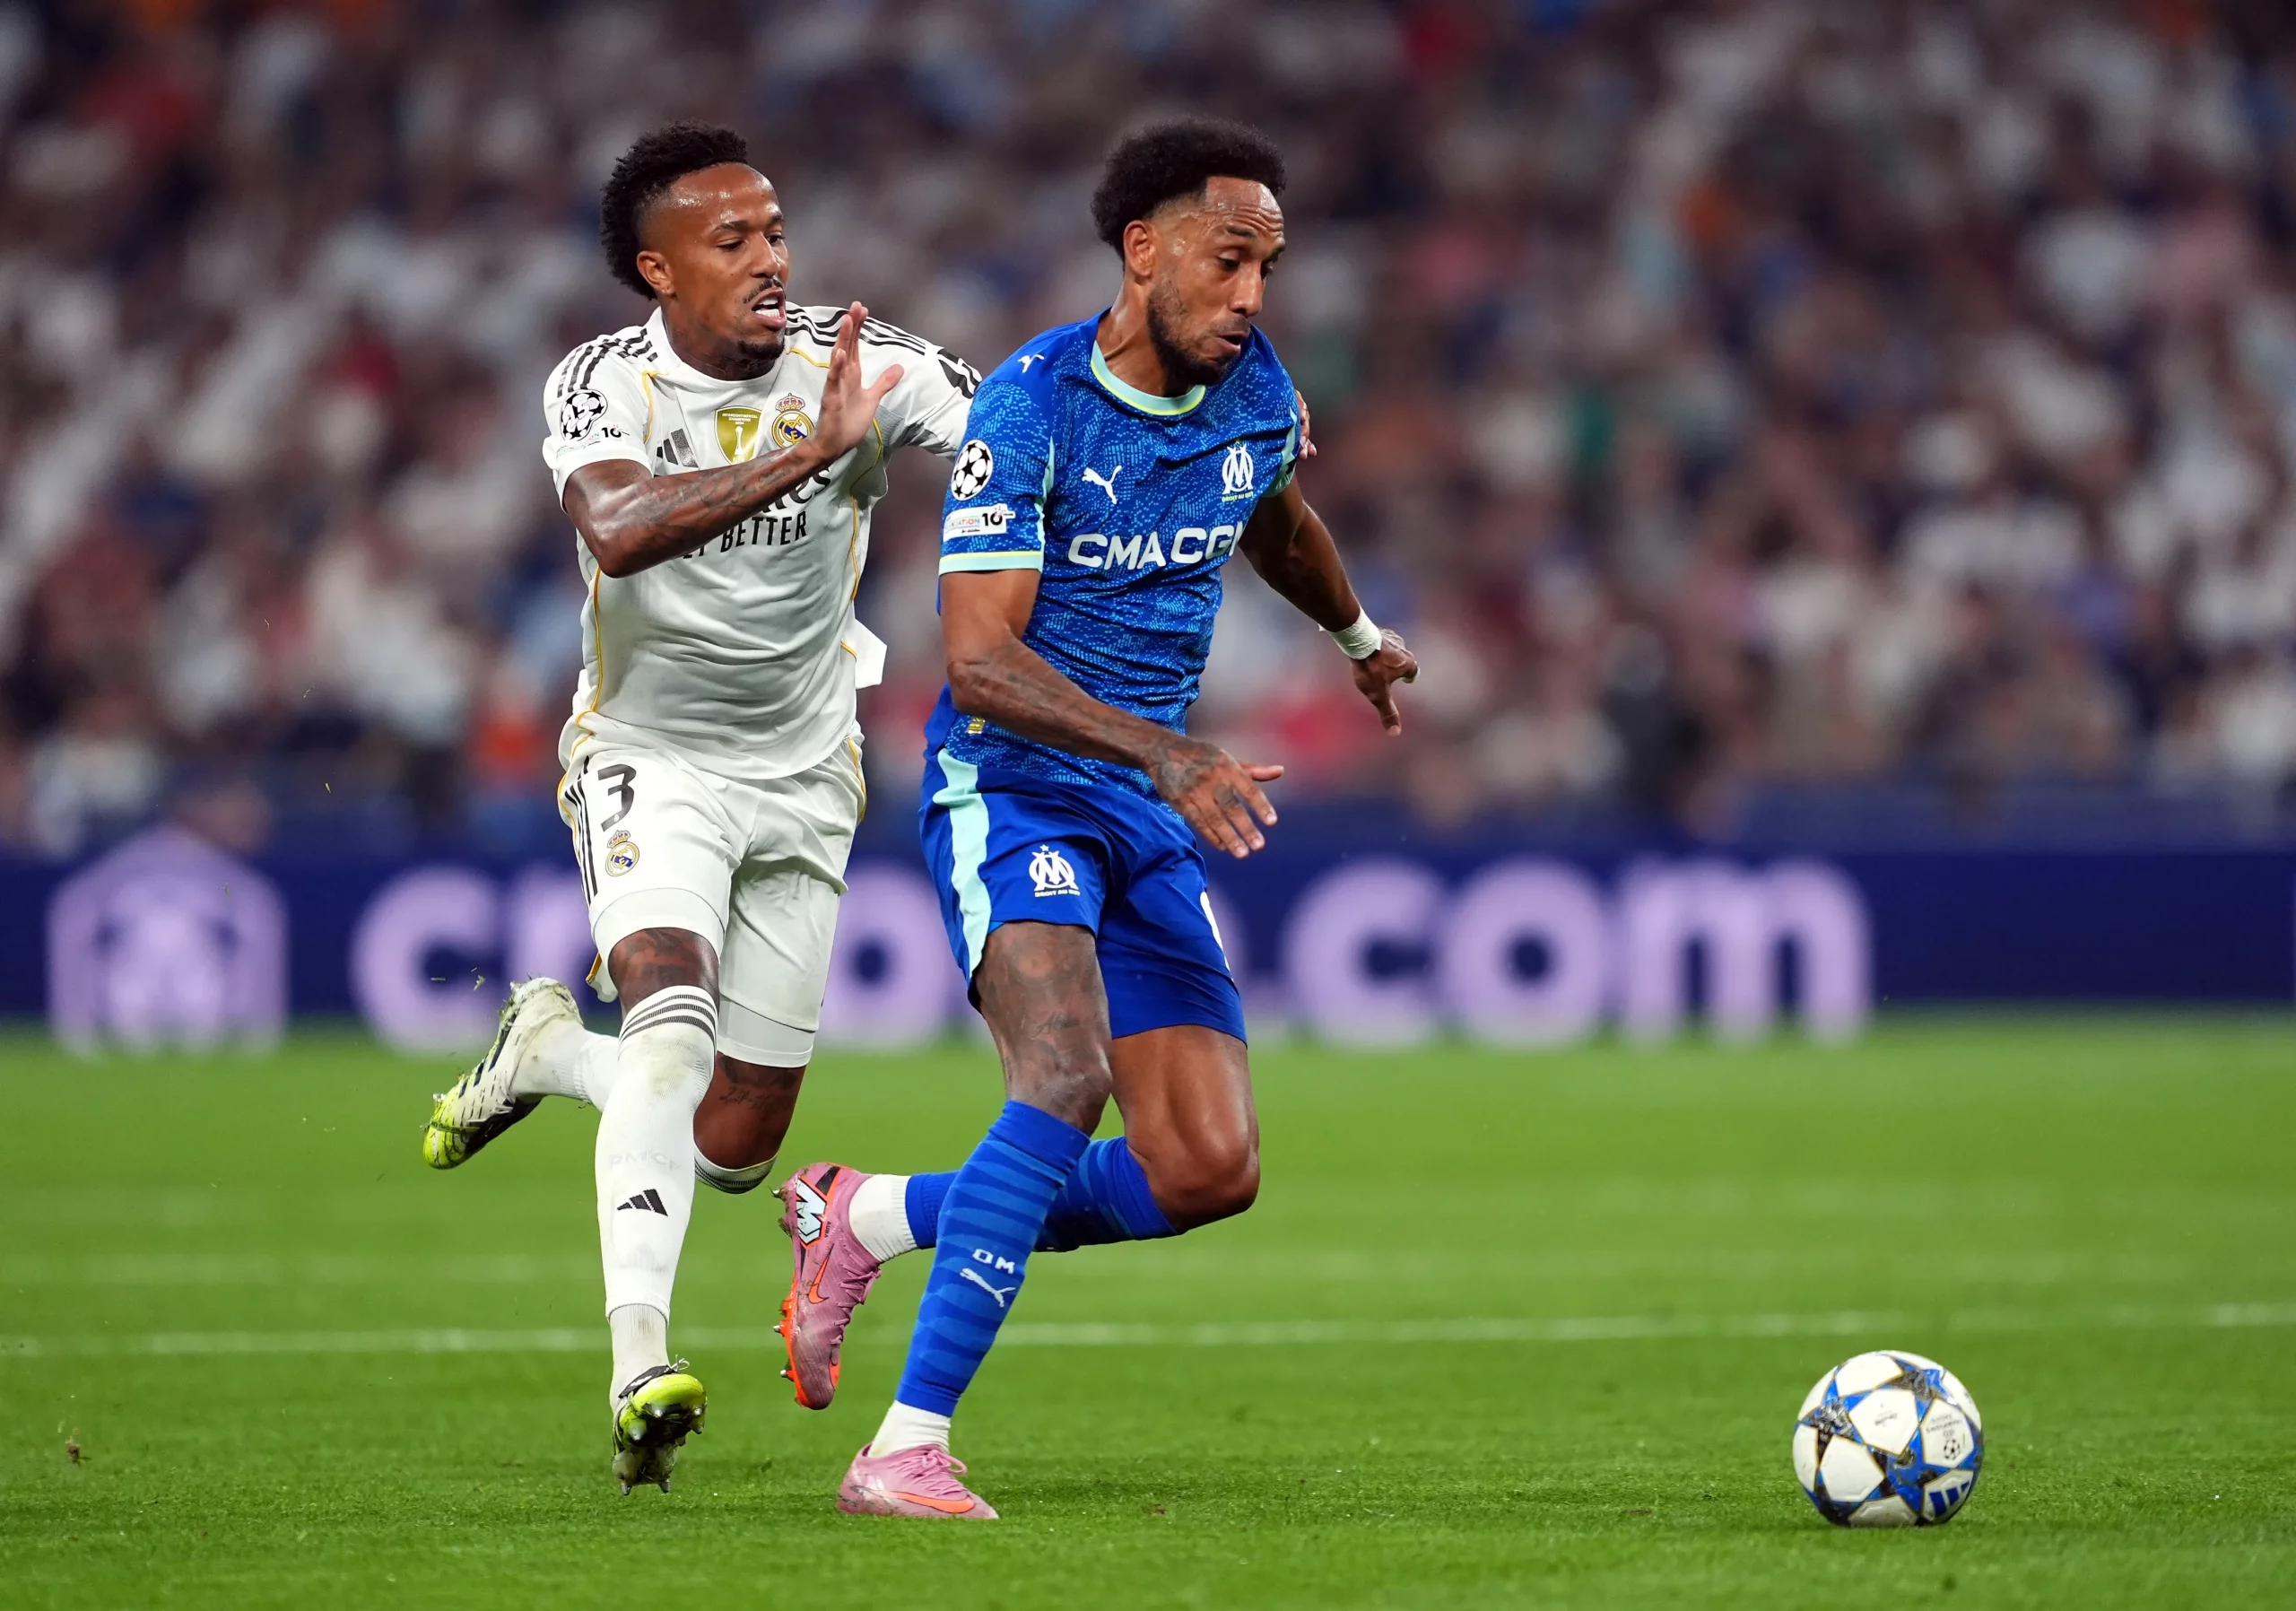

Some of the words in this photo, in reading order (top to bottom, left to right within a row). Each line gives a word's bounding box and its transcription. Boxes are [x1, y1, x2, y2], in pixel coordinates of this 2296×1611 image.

[720, 511, 807, 553] BETTER
[982, 512, 1003, 527] 10
[1067, 531, 1167, 570] CMA
[597, 763, 637, 832] 3
[972, 1248, 1015, 1275] OM
